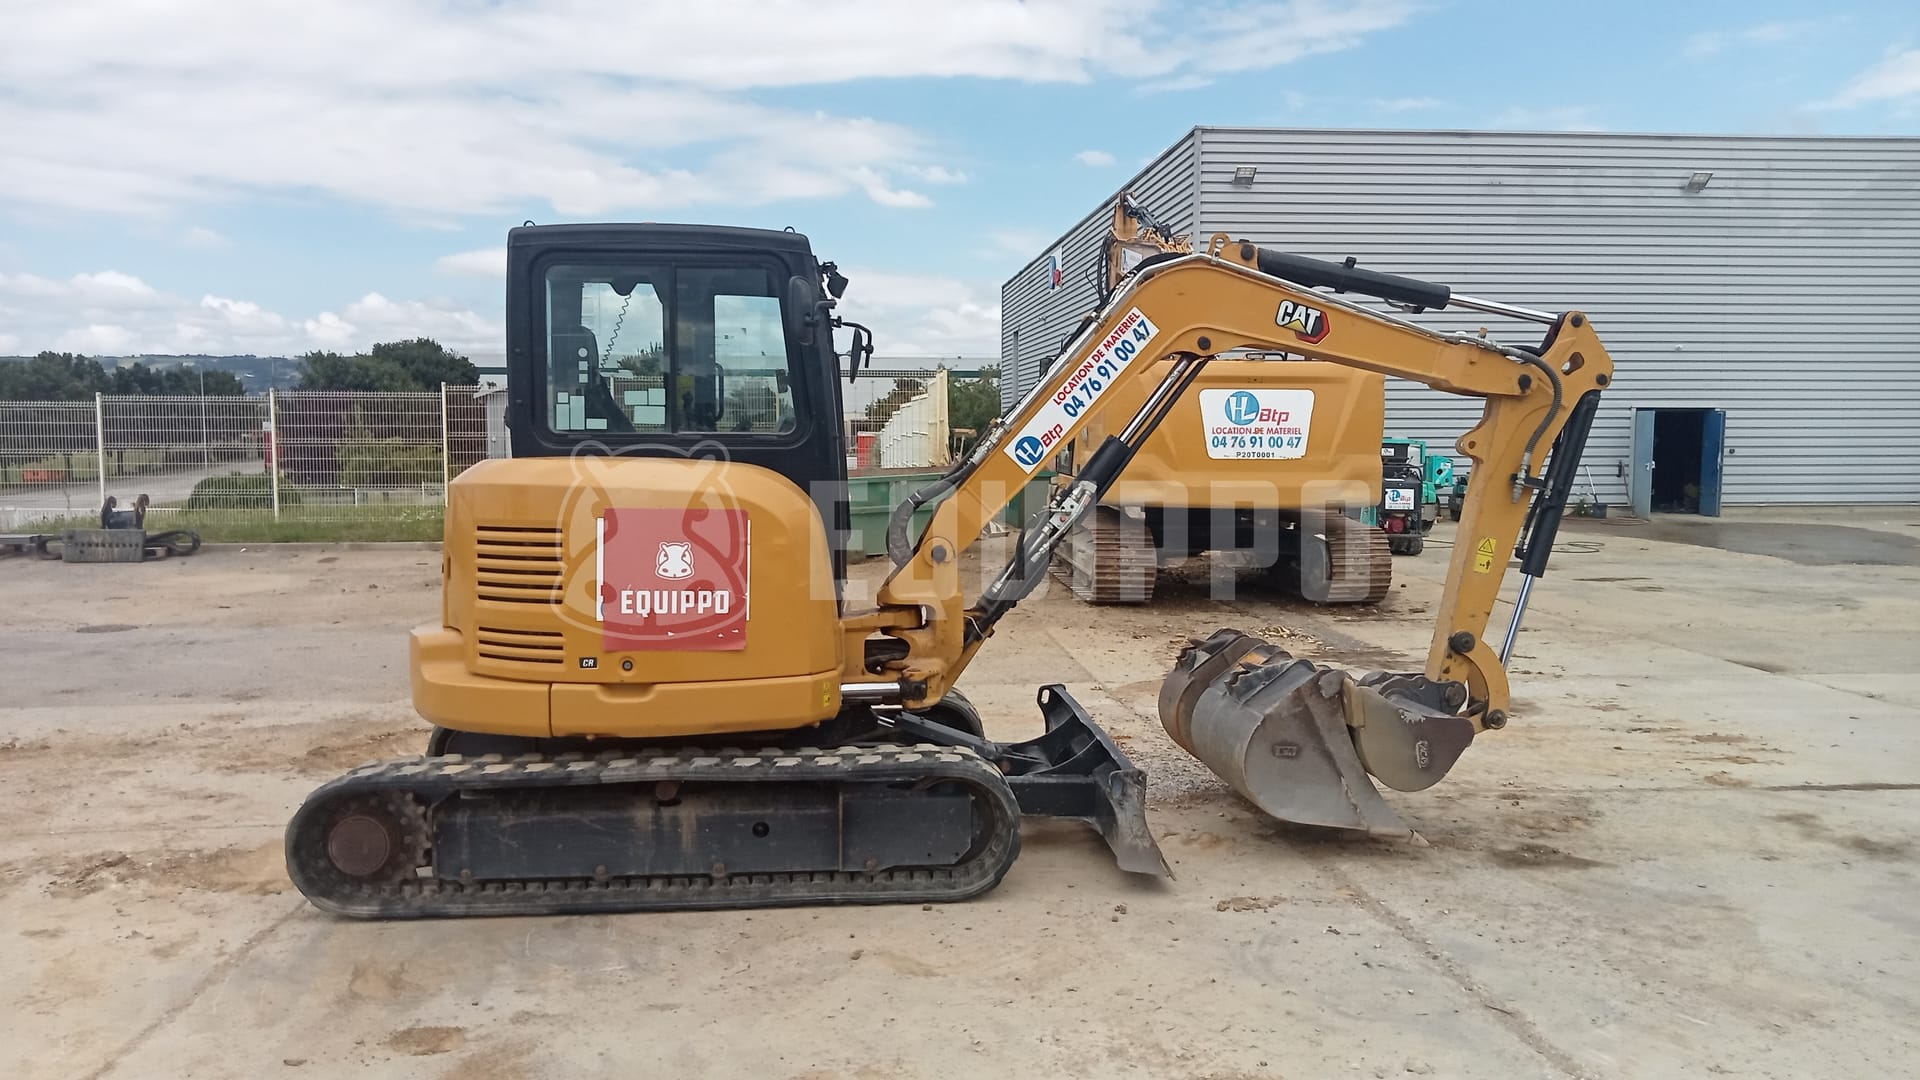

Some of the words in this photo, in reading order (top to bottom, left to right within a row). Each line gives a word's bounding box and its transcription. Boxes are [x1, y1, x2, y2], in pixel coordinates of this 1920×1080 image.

[1276, 300, 1321, 335] CAT
[1053, 361, 1095, 406] LOCATION
[1091, 349, 1106, 364] DE
[1103, 312, 1141, 352] MATERIEL
[1063, 395, 1086, 418] 04
[1079, 377, 1102, 400] 76
[1096, 358, 1119, 380] 91
[1114, 339, 1136, 362] 00
[1132, 319, 1151, 344] 47
[1226, 392, 1258, 424] HL
[1258, 408, 1290, 426] Btp
[1015, 437, 1044, 465] HL
[1040, 423, 1063, 448] Btp
[1211, 427, 1252, 435] LOCATION
[1253, 427, 1265, 435] DE
[1266, 427, 1303, 435] MATERIEL
[1211, 436, 1228, 448] 04
[1231, 436, 1246, 448] 76
[1249, 436, 1264, 448] 91
[1268, 436, 1284, 448] 00
[1286, 436, 1303, 448] 47
